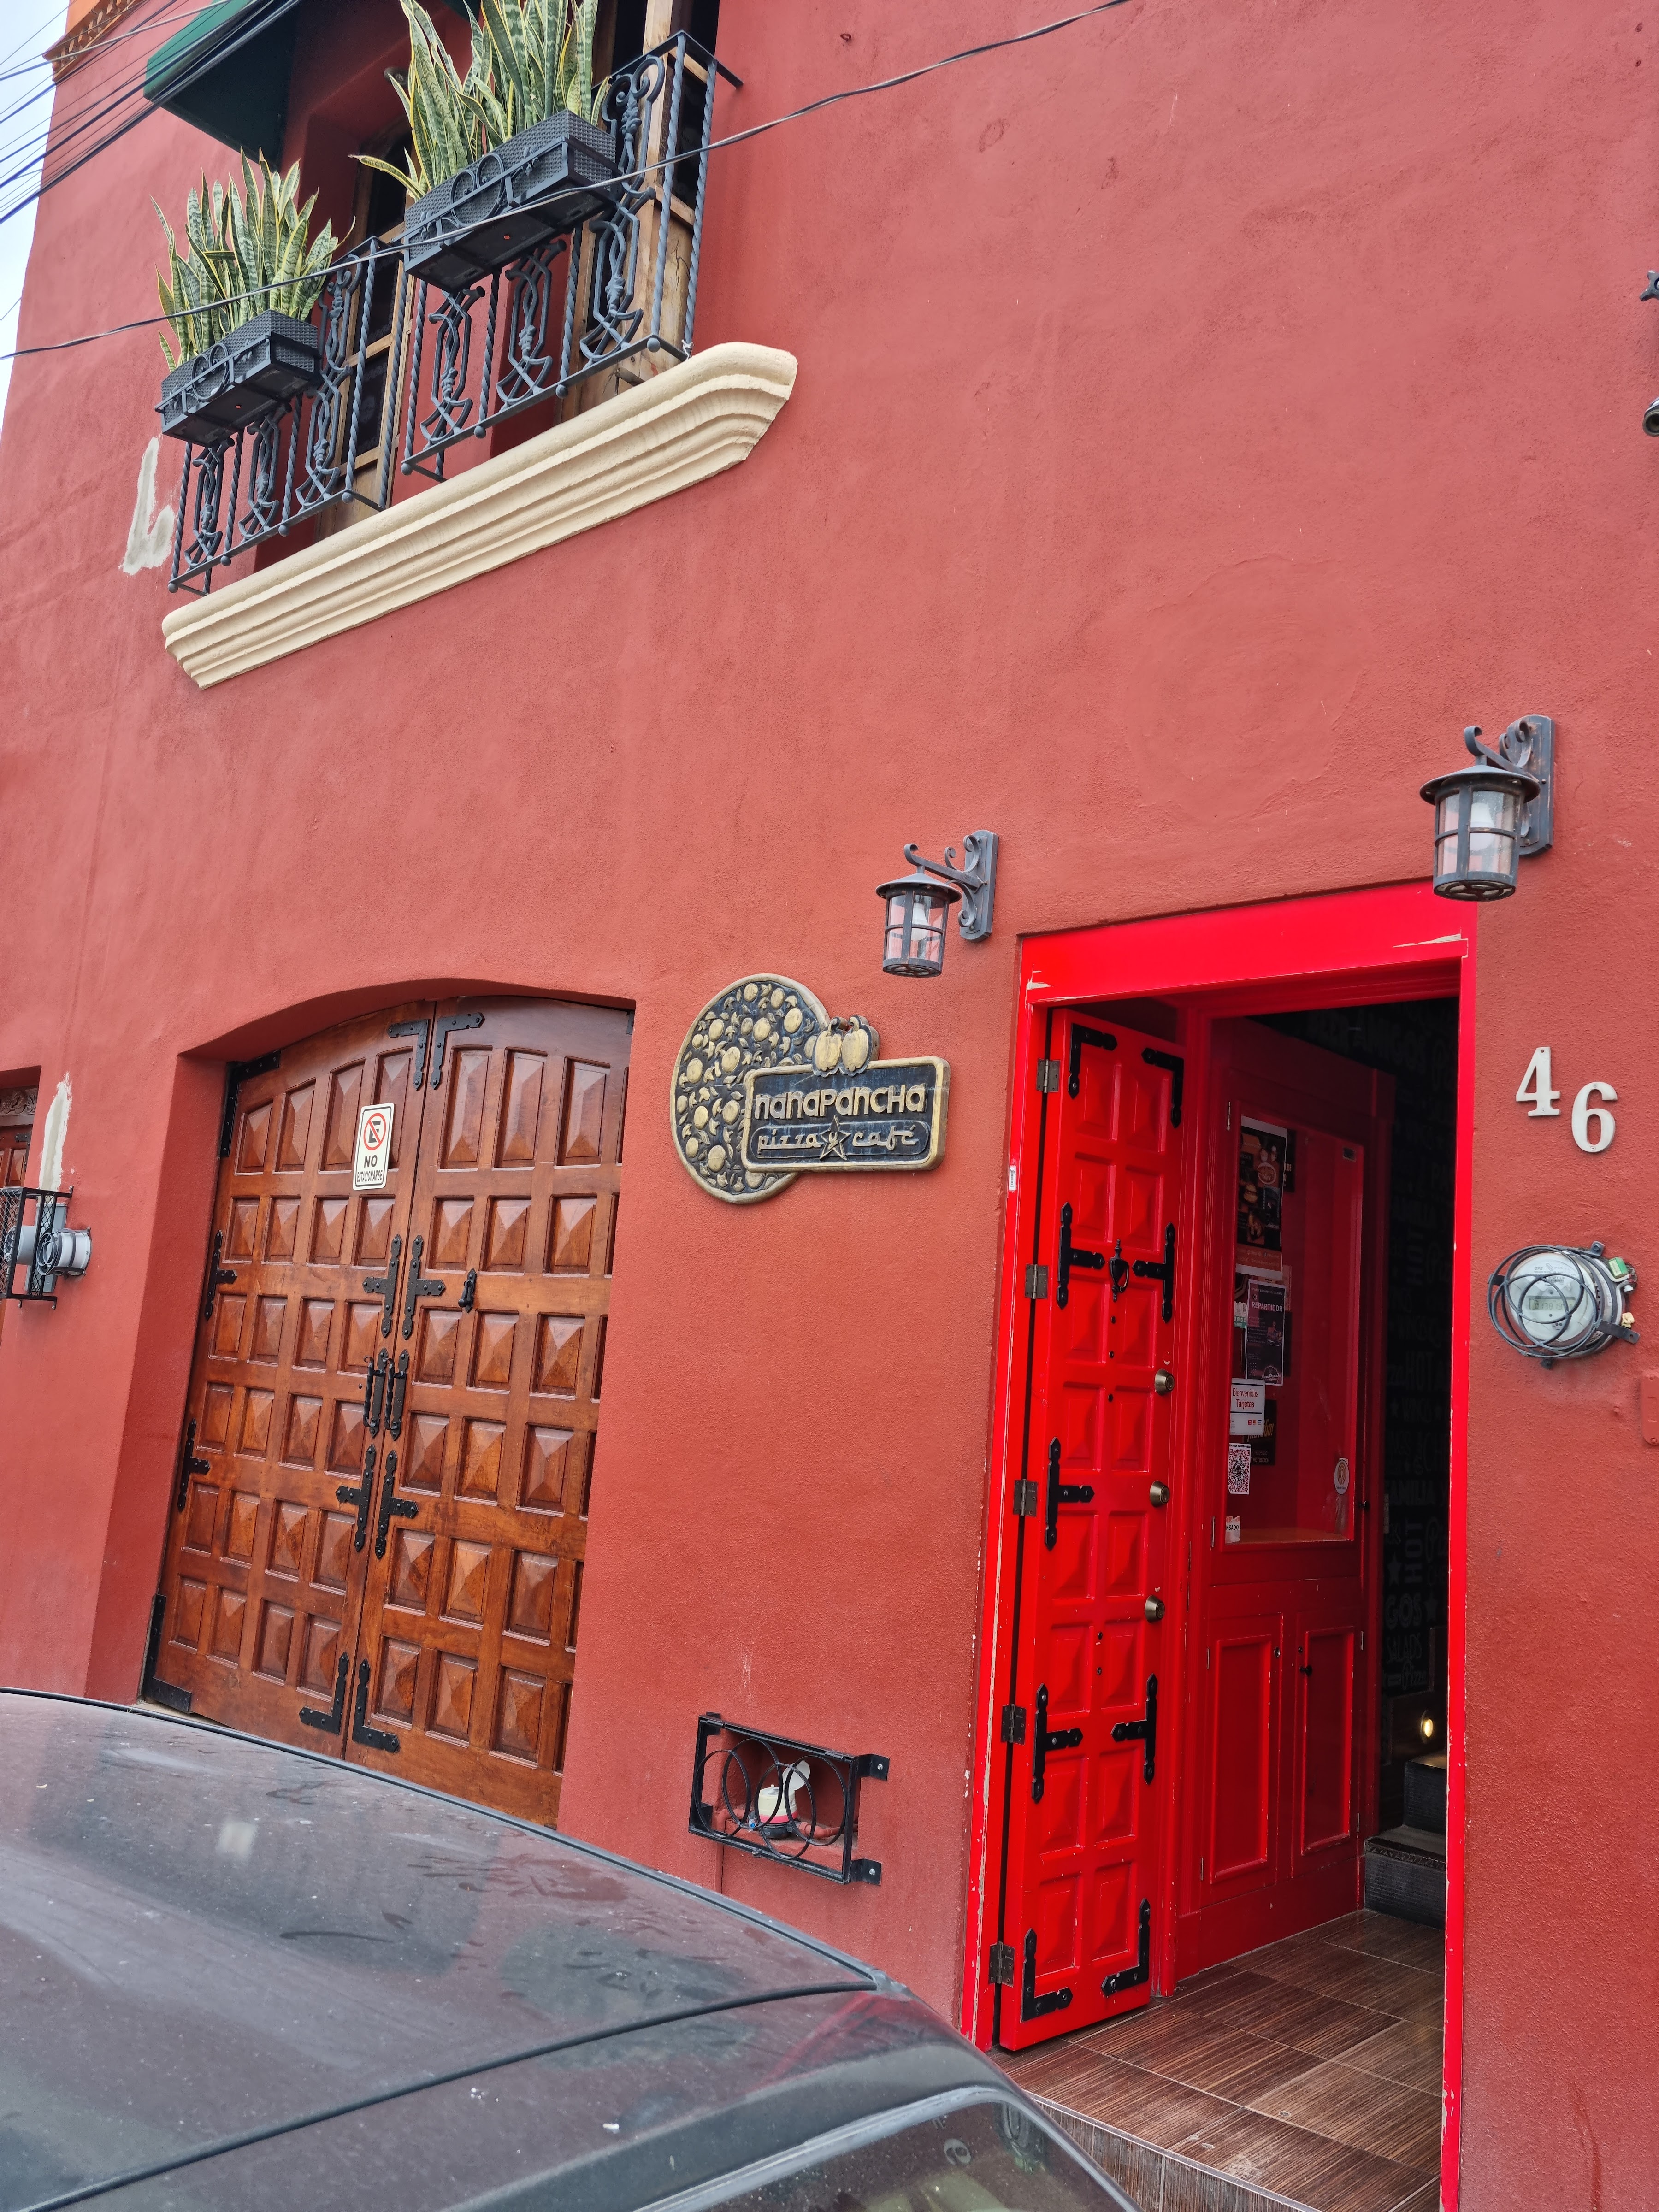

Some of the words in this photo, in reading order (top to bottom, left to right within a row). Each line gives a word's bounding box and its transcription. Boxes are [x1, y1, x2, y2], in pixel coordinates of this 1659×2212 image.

[757, 1129, 823, 1154] pizza
[364, 1155, 378, 1168] NO
[357, 1169, 383, 1183] ESTACIONARSE
[1252, 1301, 1283, 1312] REPARTIDOR
[1233, 1388, 1258, 1398] Bienvenidas
[1236, 1398, 1254, 1410] Tarjetas
